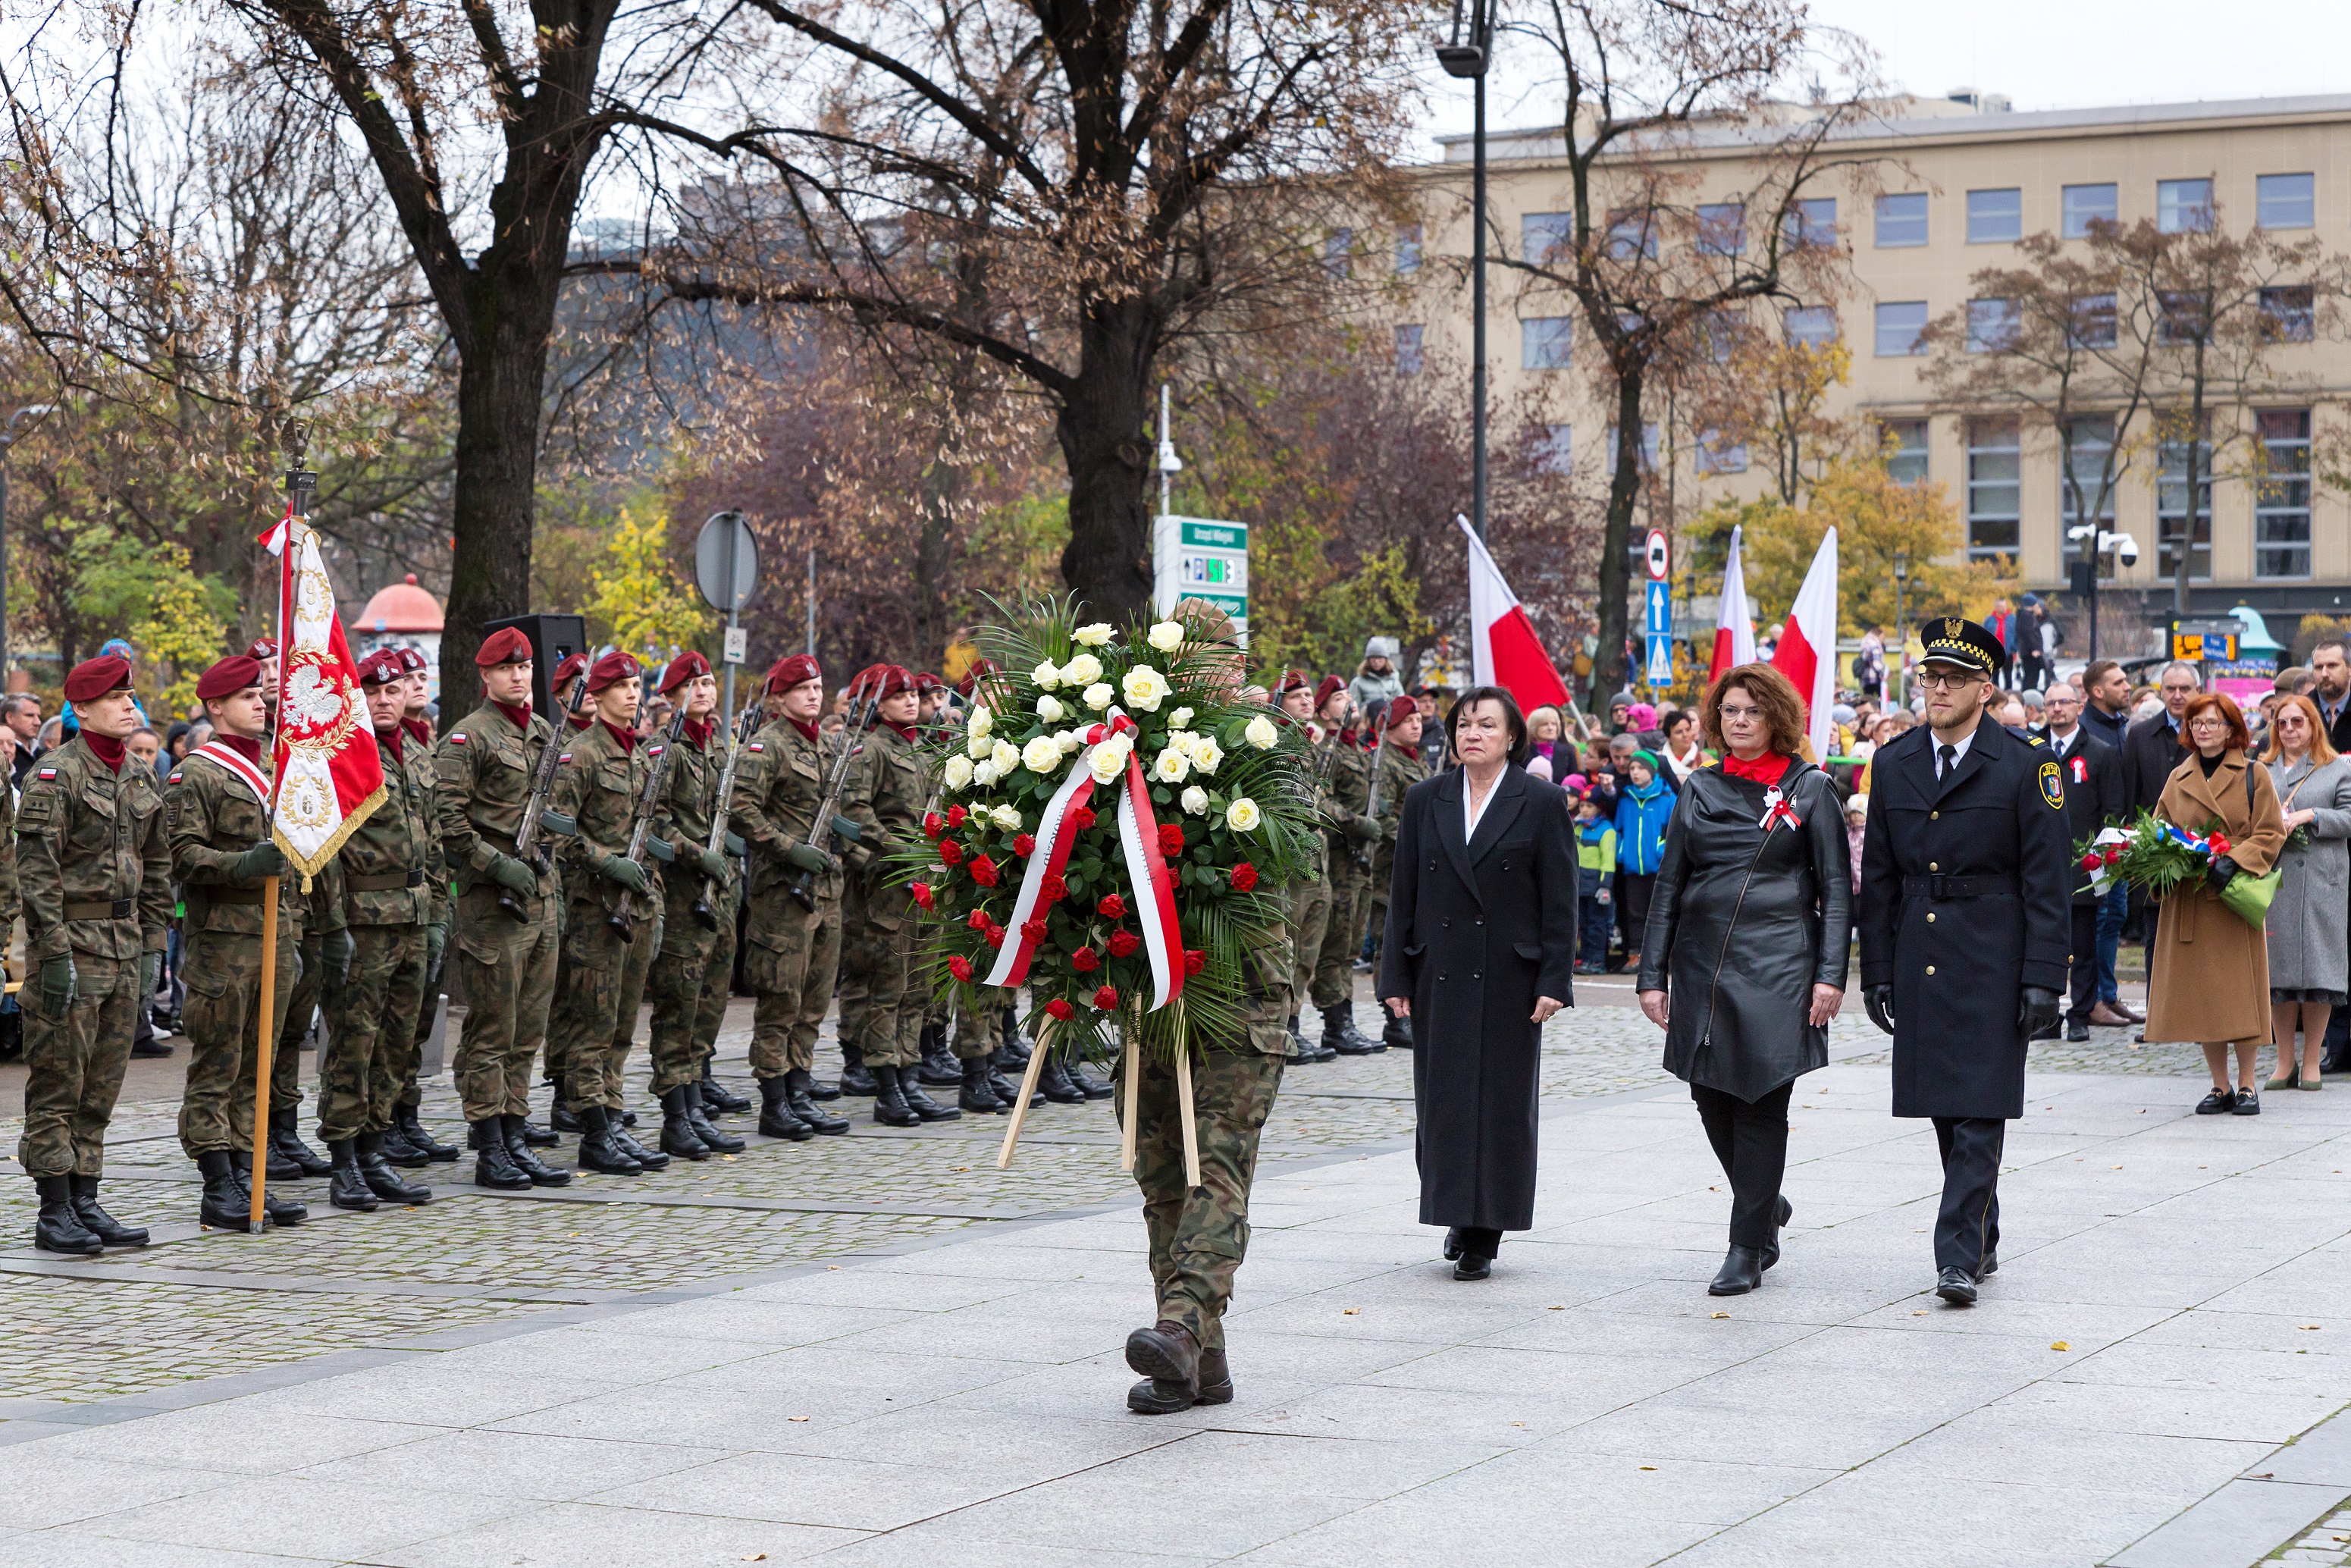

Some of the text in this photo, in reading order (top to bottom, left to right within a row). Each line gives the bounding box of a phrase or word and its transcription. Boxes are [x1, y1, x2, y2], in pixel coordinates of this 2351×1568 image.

[306, 581, 317, 605] 9
[302, 789, 314, 814] 6
[1043, 797, 1073, 867] SAMORZĄD
[1124, 782, 1156, 886] MIASTA GLIWICE
